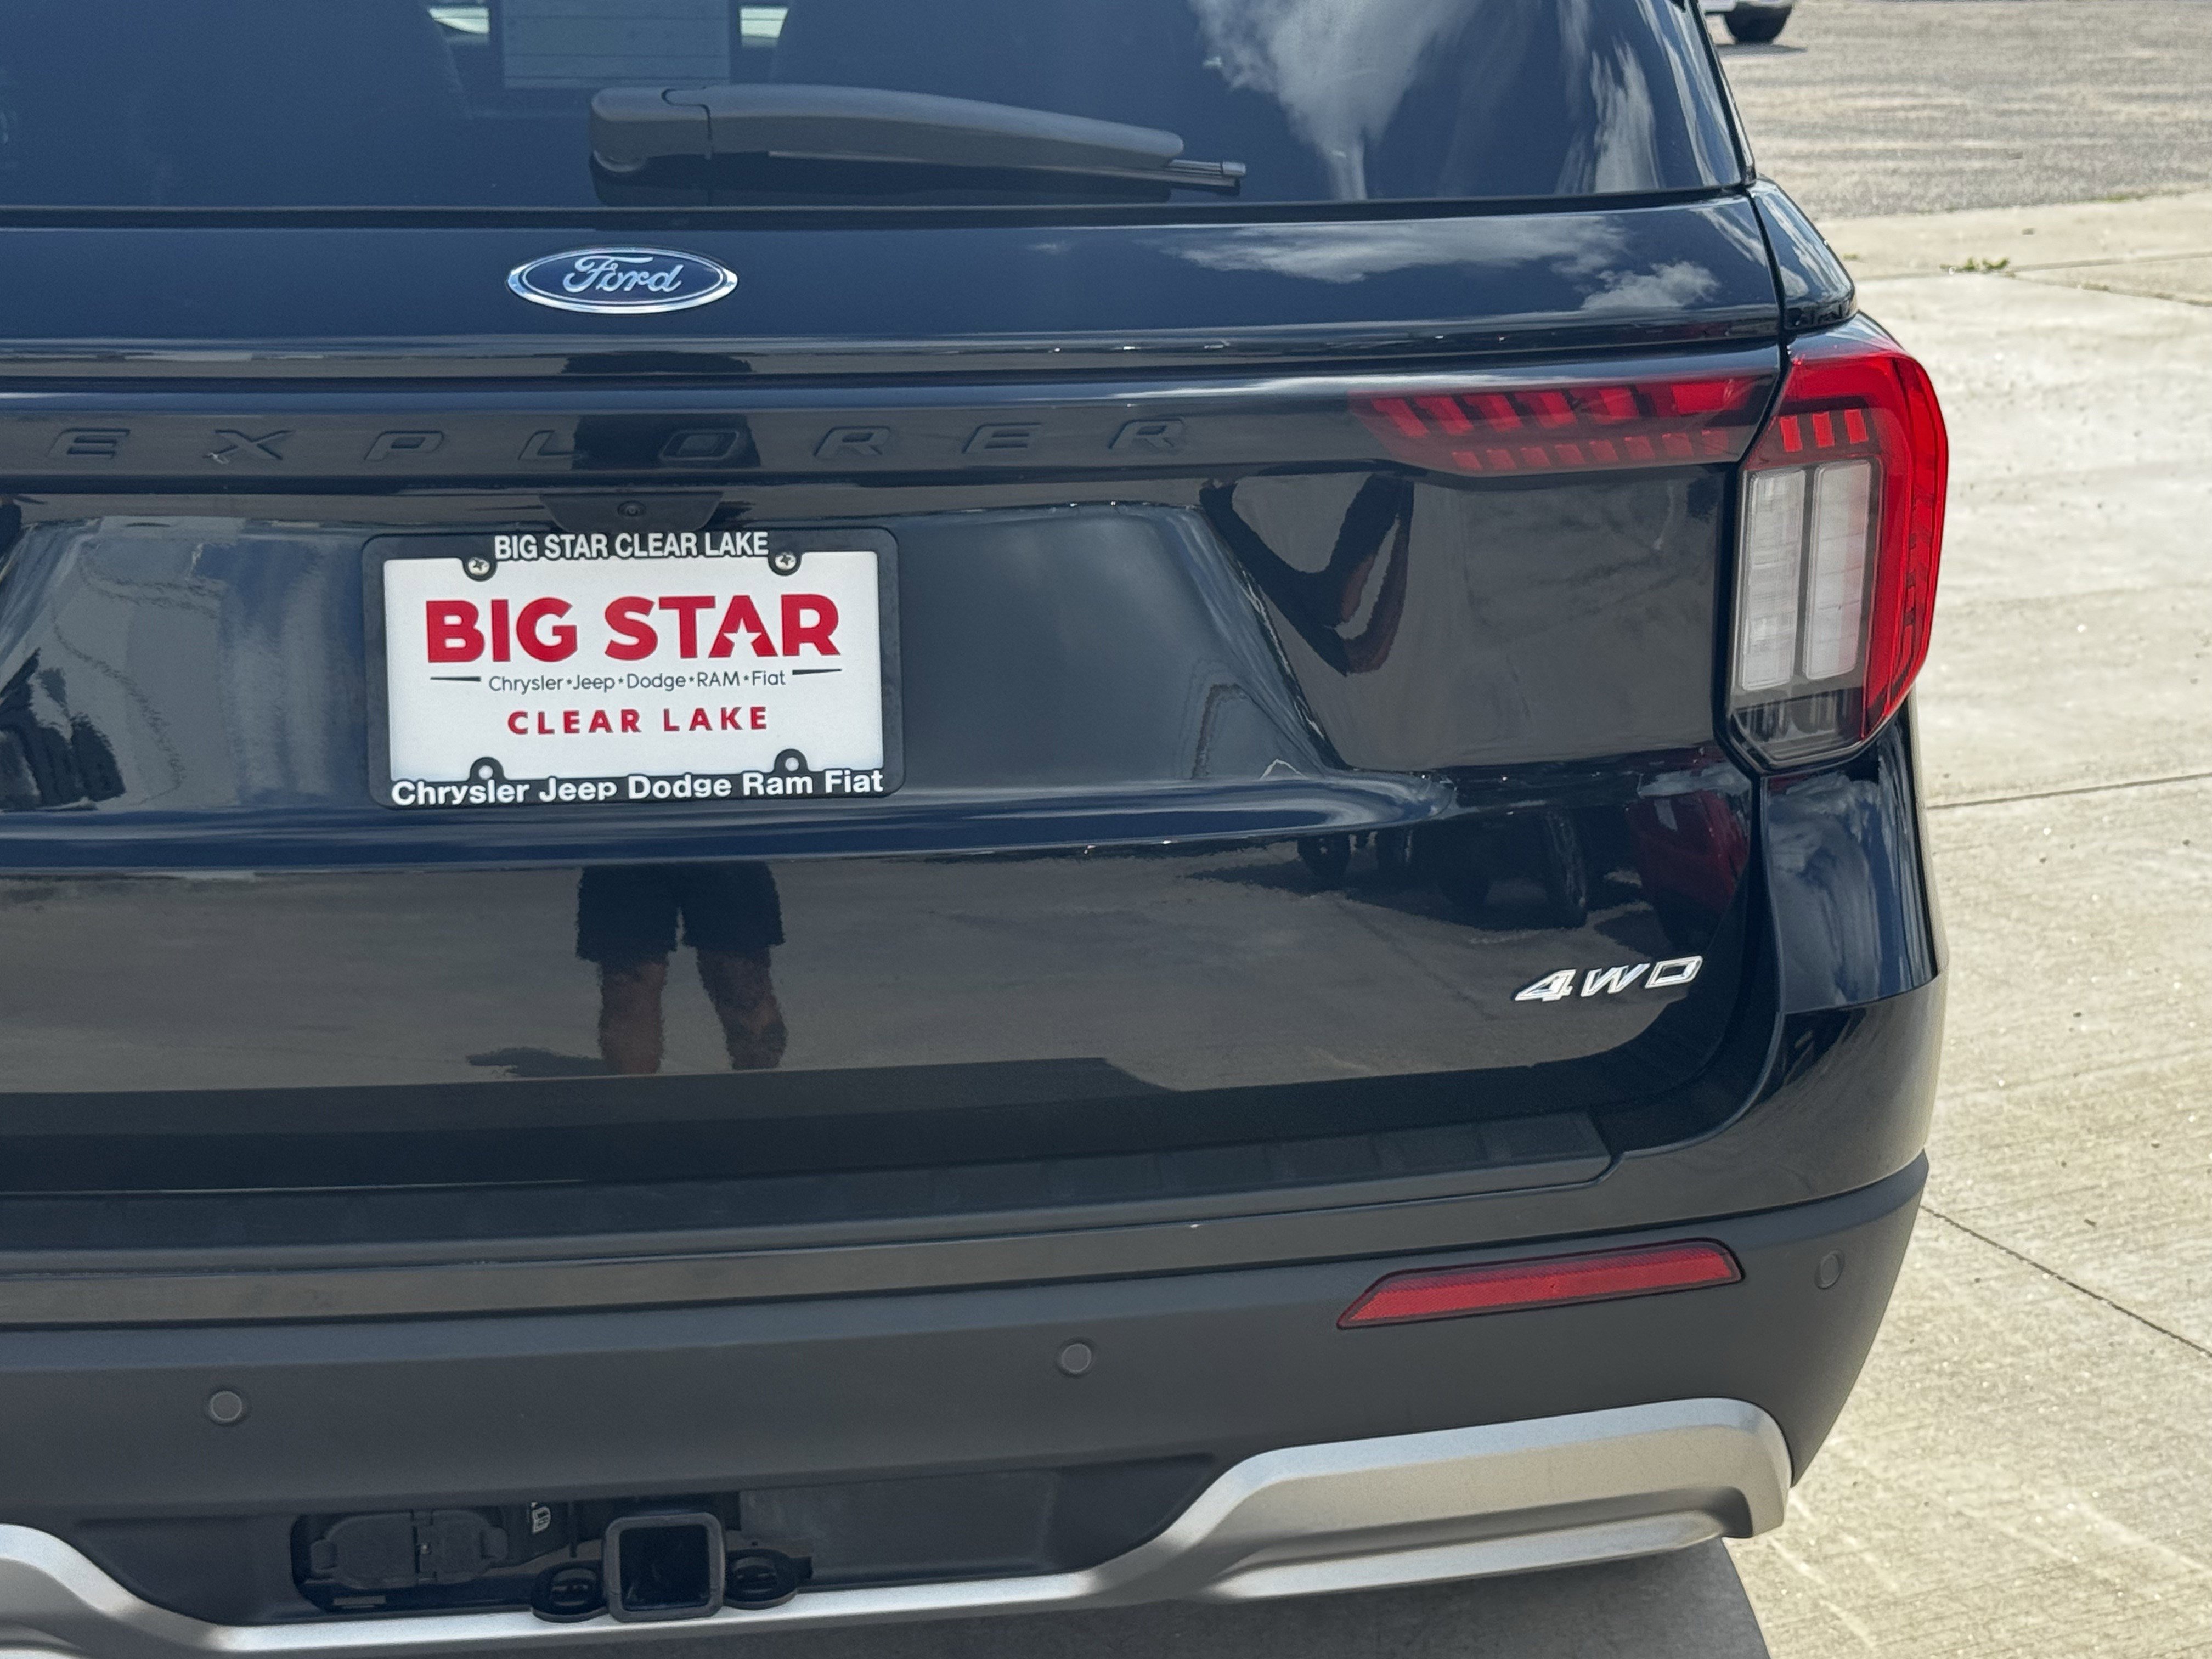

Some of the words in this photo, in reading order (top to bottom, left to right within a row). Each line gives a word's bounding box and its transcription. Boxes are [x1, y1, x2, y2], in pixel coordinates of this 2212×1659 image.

[562, 255, 684, 293] Ford
[46, 417, 1187, 462] EXPLORER
[494, 535, 538, 560] BIG
[544, 533, 608, 558] STAR
[615, 532, 698, 557] CLEAR
[704, 531, 769, 556] LAKE
[426, 597, 578, 663] BIG
[604, 594, 842, 661] STAR
[489, 675, 564, 695] Chrysler
[573, 674, 616, 693] Jeep
[627, 673, 686, 691] Dodge
[697, 672, 740, 687] RAM
[752, 670, 786, 686] Fiat
[507, 709, 642, 735] CLEAR
[664, 706, 768, 732] LAKE
[391, 778, 531, 806] Chrysler
[538, 775, 618, 802] Jeep
[628, 774, 732, 799] Dodge
[743, 772, 814, 796] Ram
[825, 769, 884, 793] Fiat
[1513, 955, 1703, 1002] 4WD
